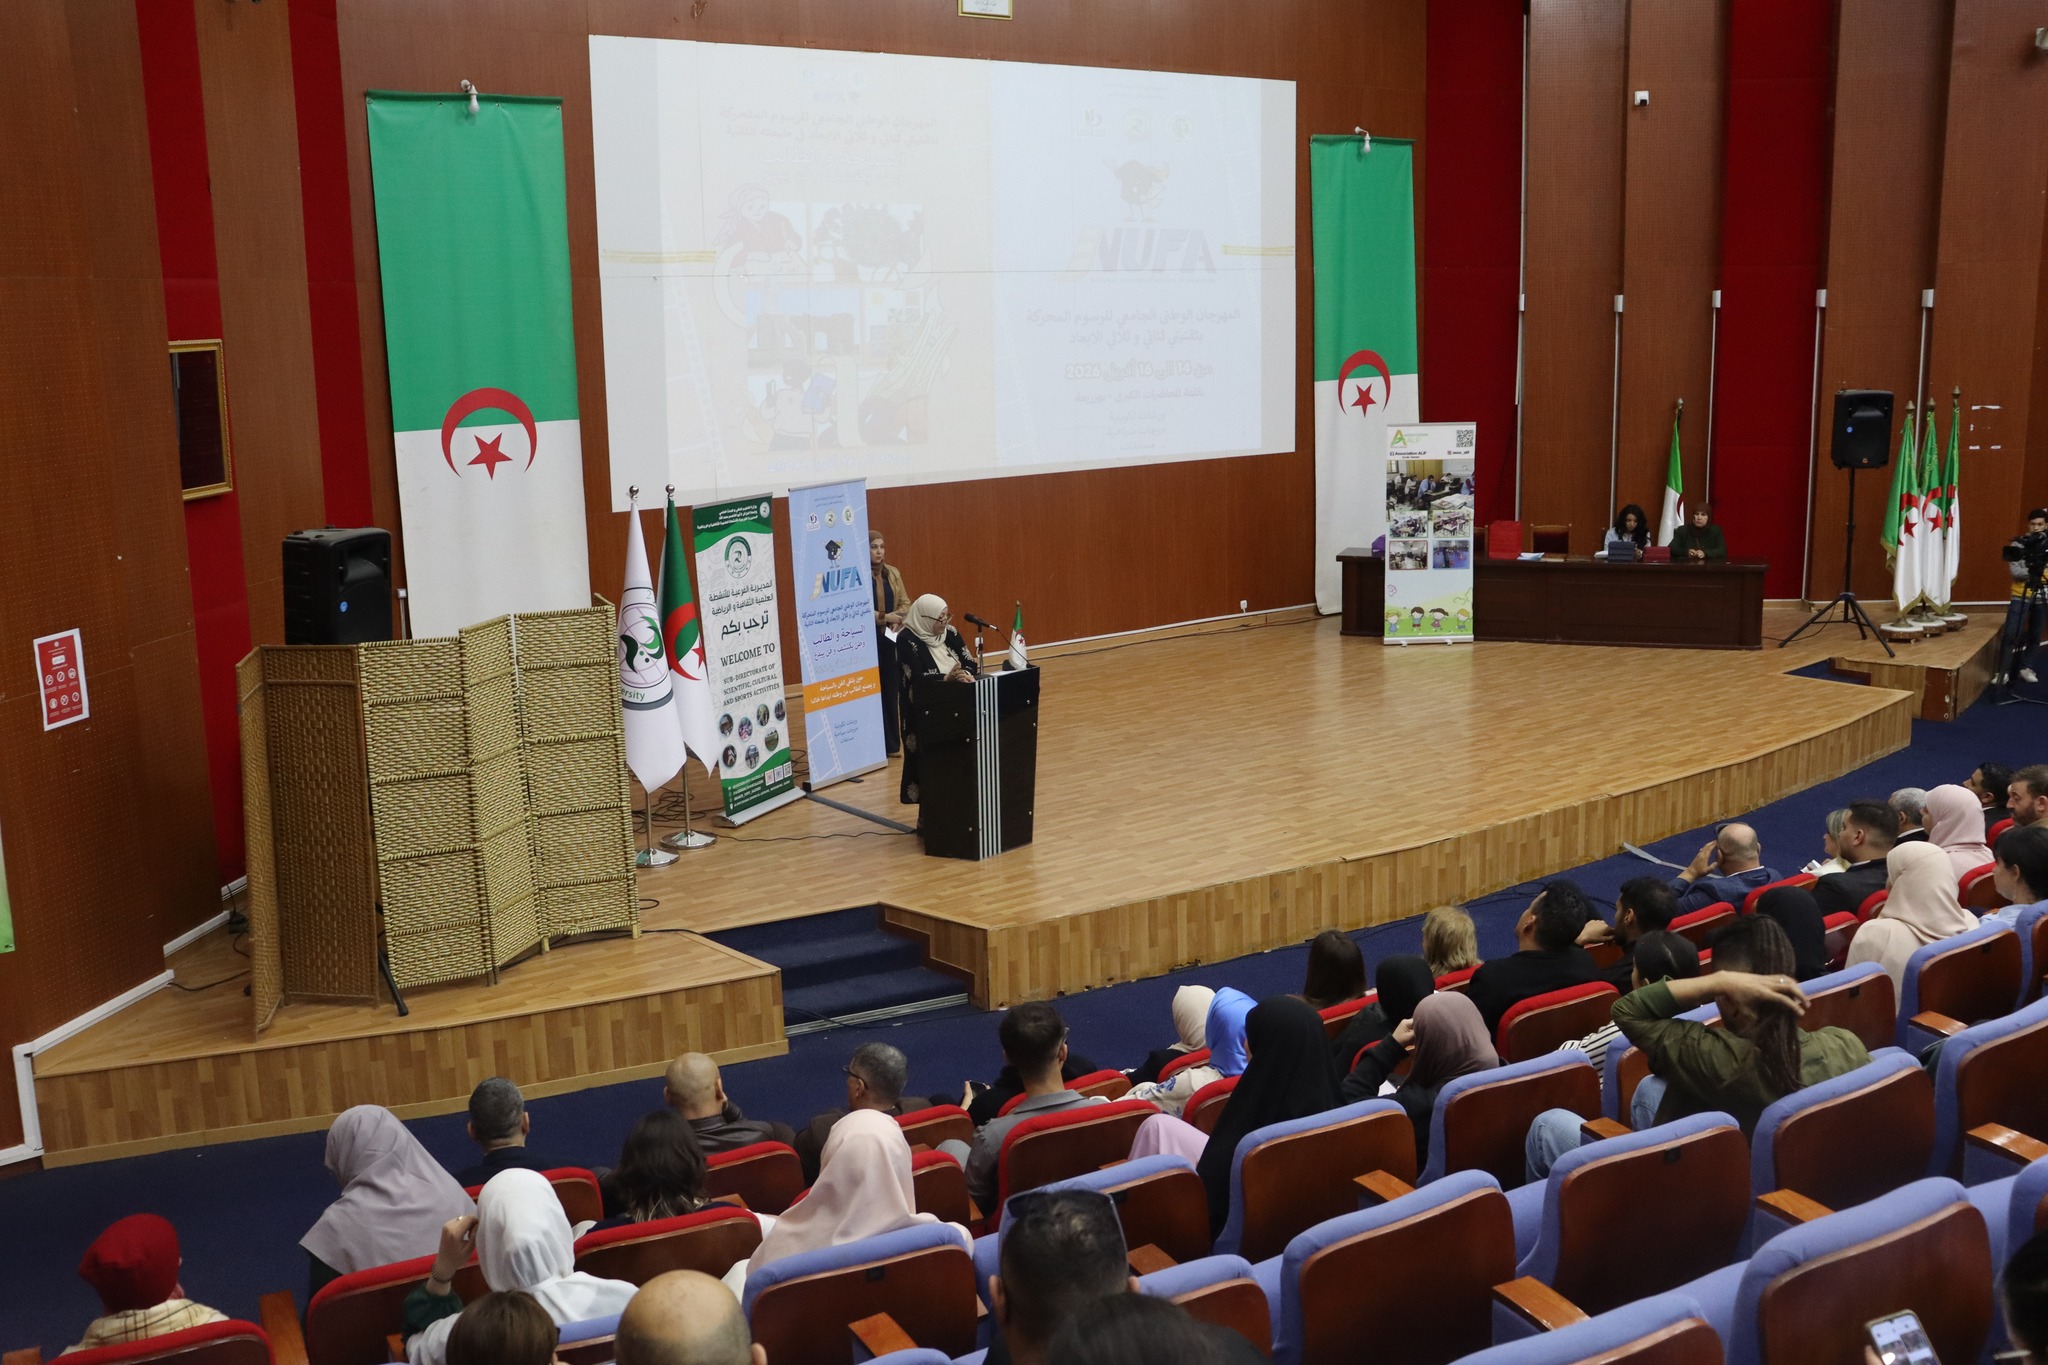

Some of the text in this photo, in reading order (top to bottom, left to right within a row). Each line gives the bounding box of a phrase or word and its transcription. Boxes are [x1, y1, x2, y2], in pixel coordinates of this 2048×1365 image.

[1078, 226, 1217, 276] NUFA
[1065, 362, 1101, 380] 2026
[1138, 361, 1154, 377] 16
[1175, 360, 1192, 376] 14
[1193, 362, 1213, 378] من
[815, 566, 862, 597] NUFA
[721, 620, 741, 640] بكم
[813, 625, 865, 647] السياحة و الطالب
[720, 643, 775, 667] WELCOME TO
[723, 665, 767, 684] SUB-DIRECTORATE
[723, 673, 777, 695] SCIENTIFIC, CULTURAL
[723, 682, 780, 707] AND SPORTS ACTIVITIES
